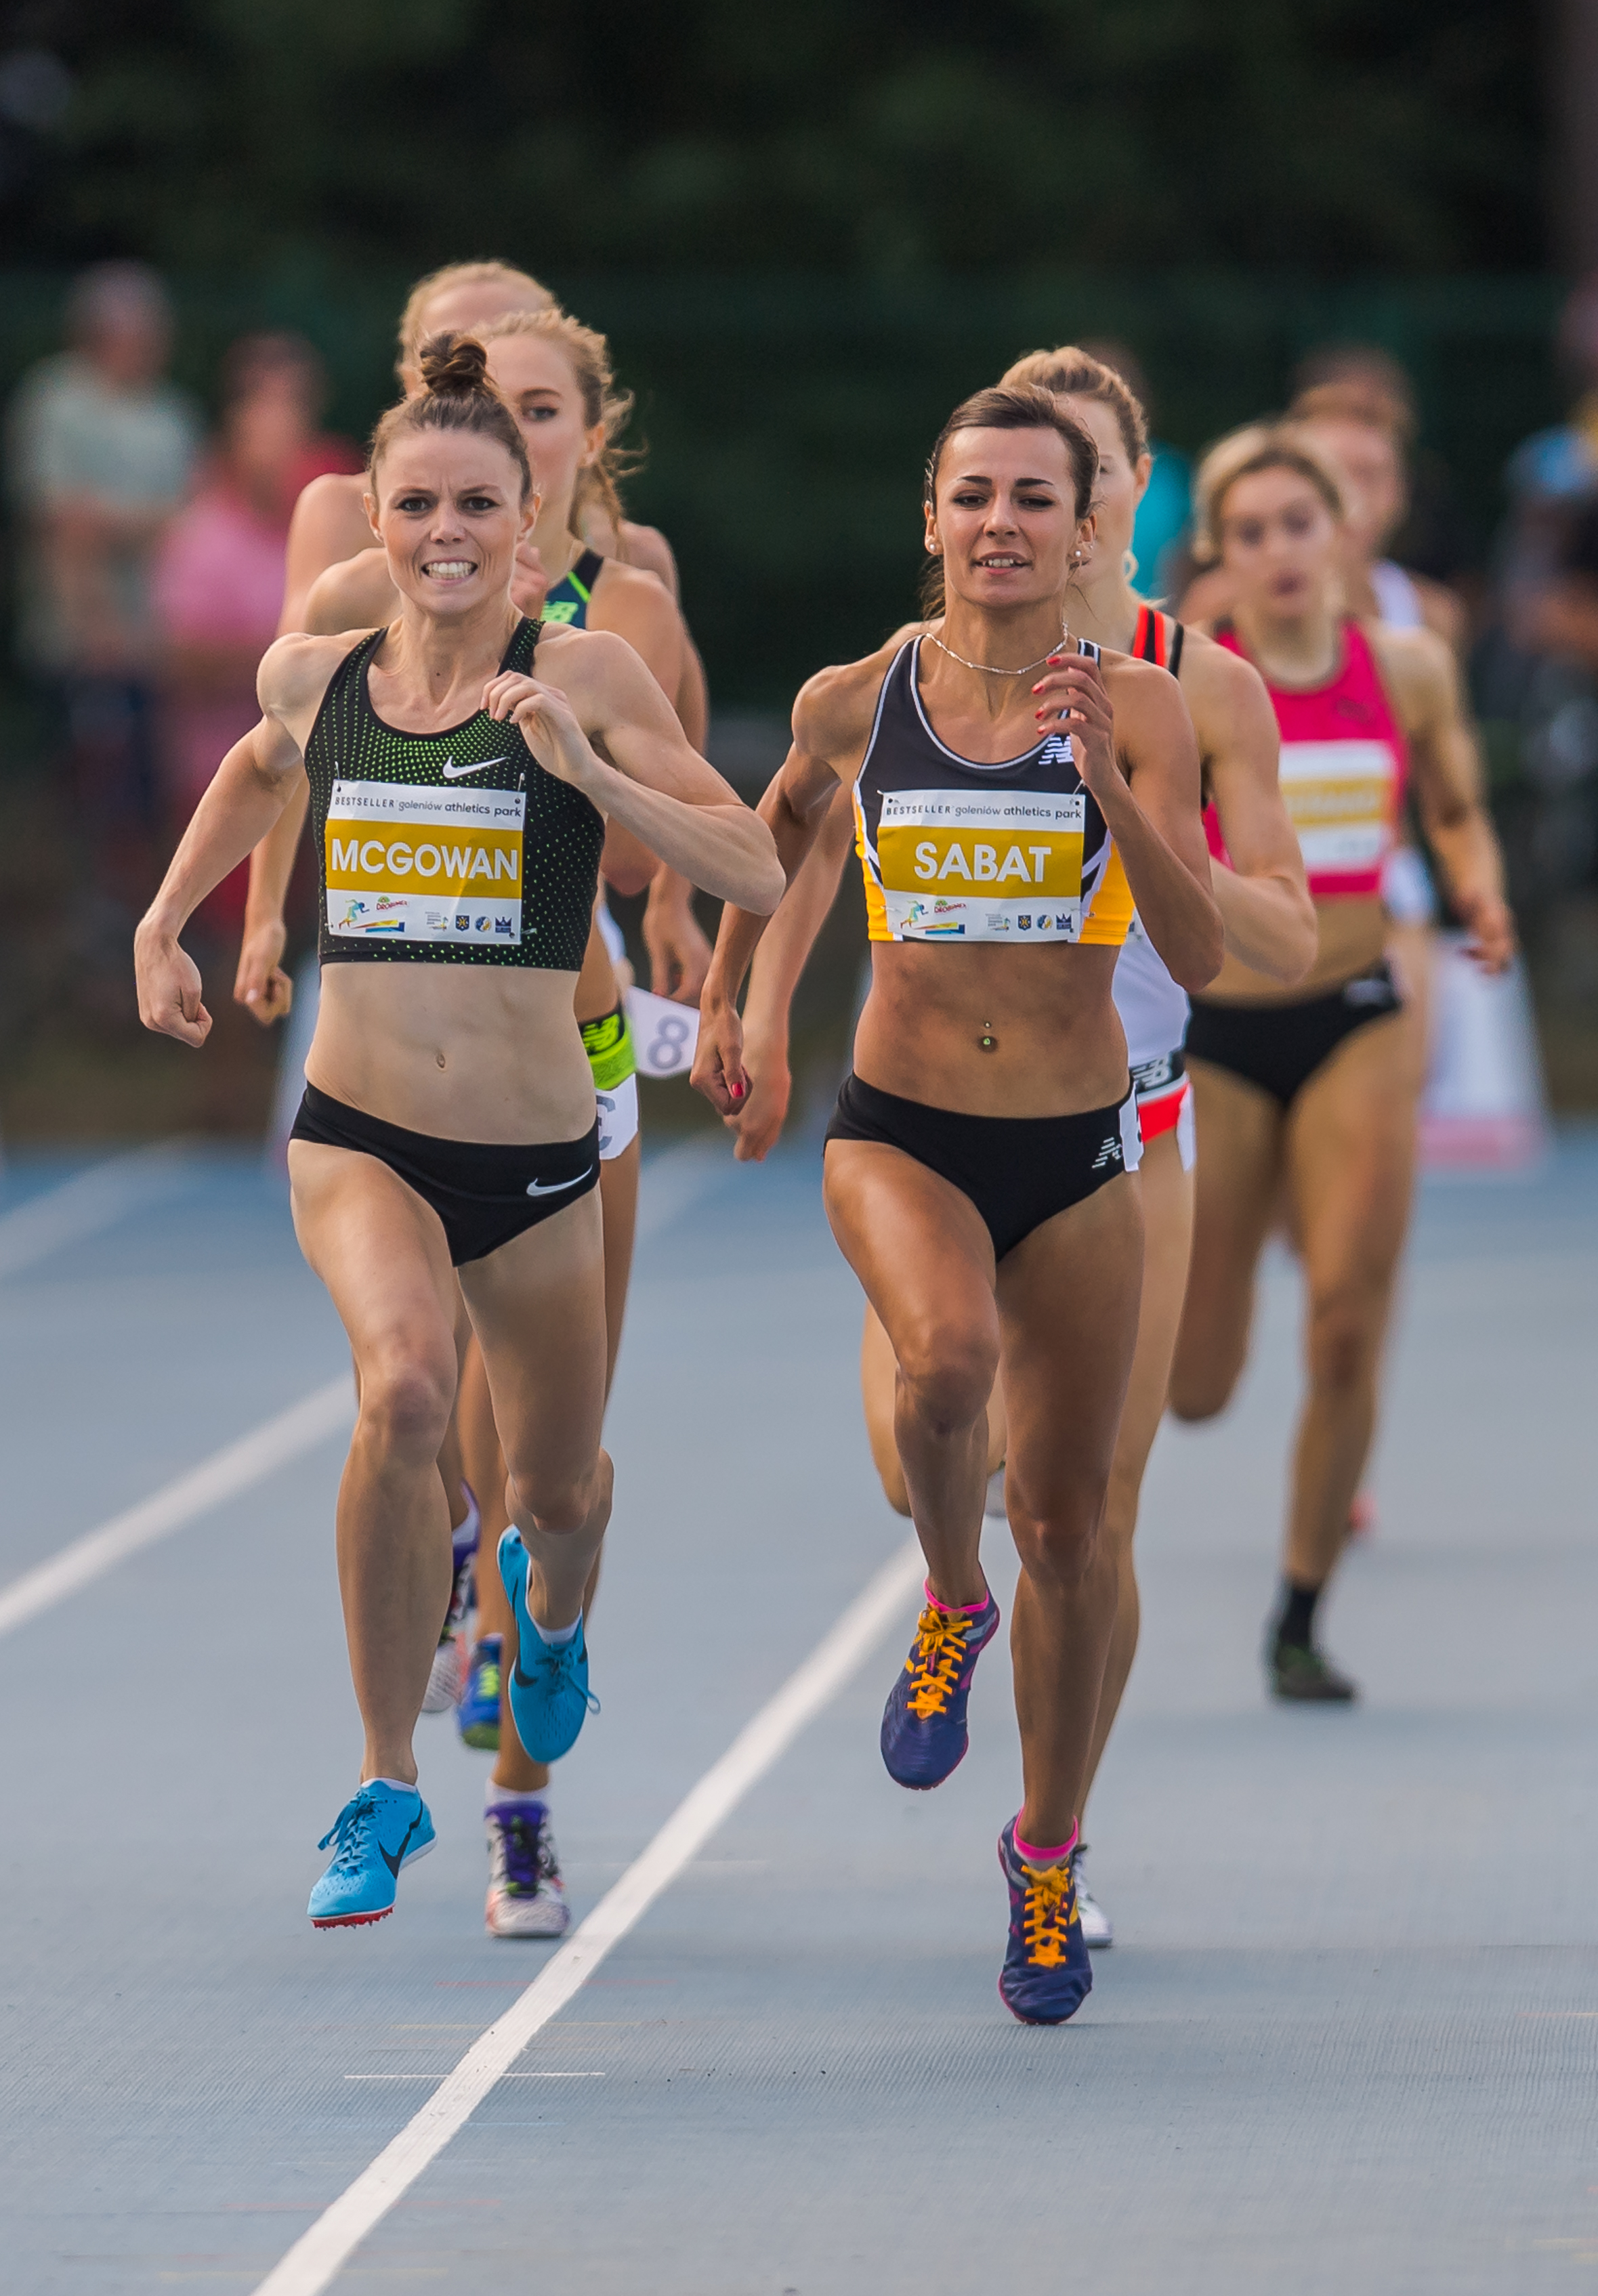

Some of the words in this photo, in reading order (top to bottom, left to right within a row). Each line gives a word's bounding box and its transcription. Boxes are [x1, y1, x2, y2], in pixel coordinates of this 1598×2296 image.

[334, 796, 395, 808] BESTSELLER
[398, 800, 442, 812] goleniów
[444, 802, 491, 814] athletics
[494, 807, 522, 817] park
[886, 805, 951, 815] BESTSELLER
[954, 805, 1001, 817] goleniów
[1003, 806, 1051, 817] athletics
[1055, 809, 1082, 820] park
[331, 838, 518, 880] MCGOWAN
[914, 841, 1052, 883] SABAT
[647, 1015, 690, 1069] 8
